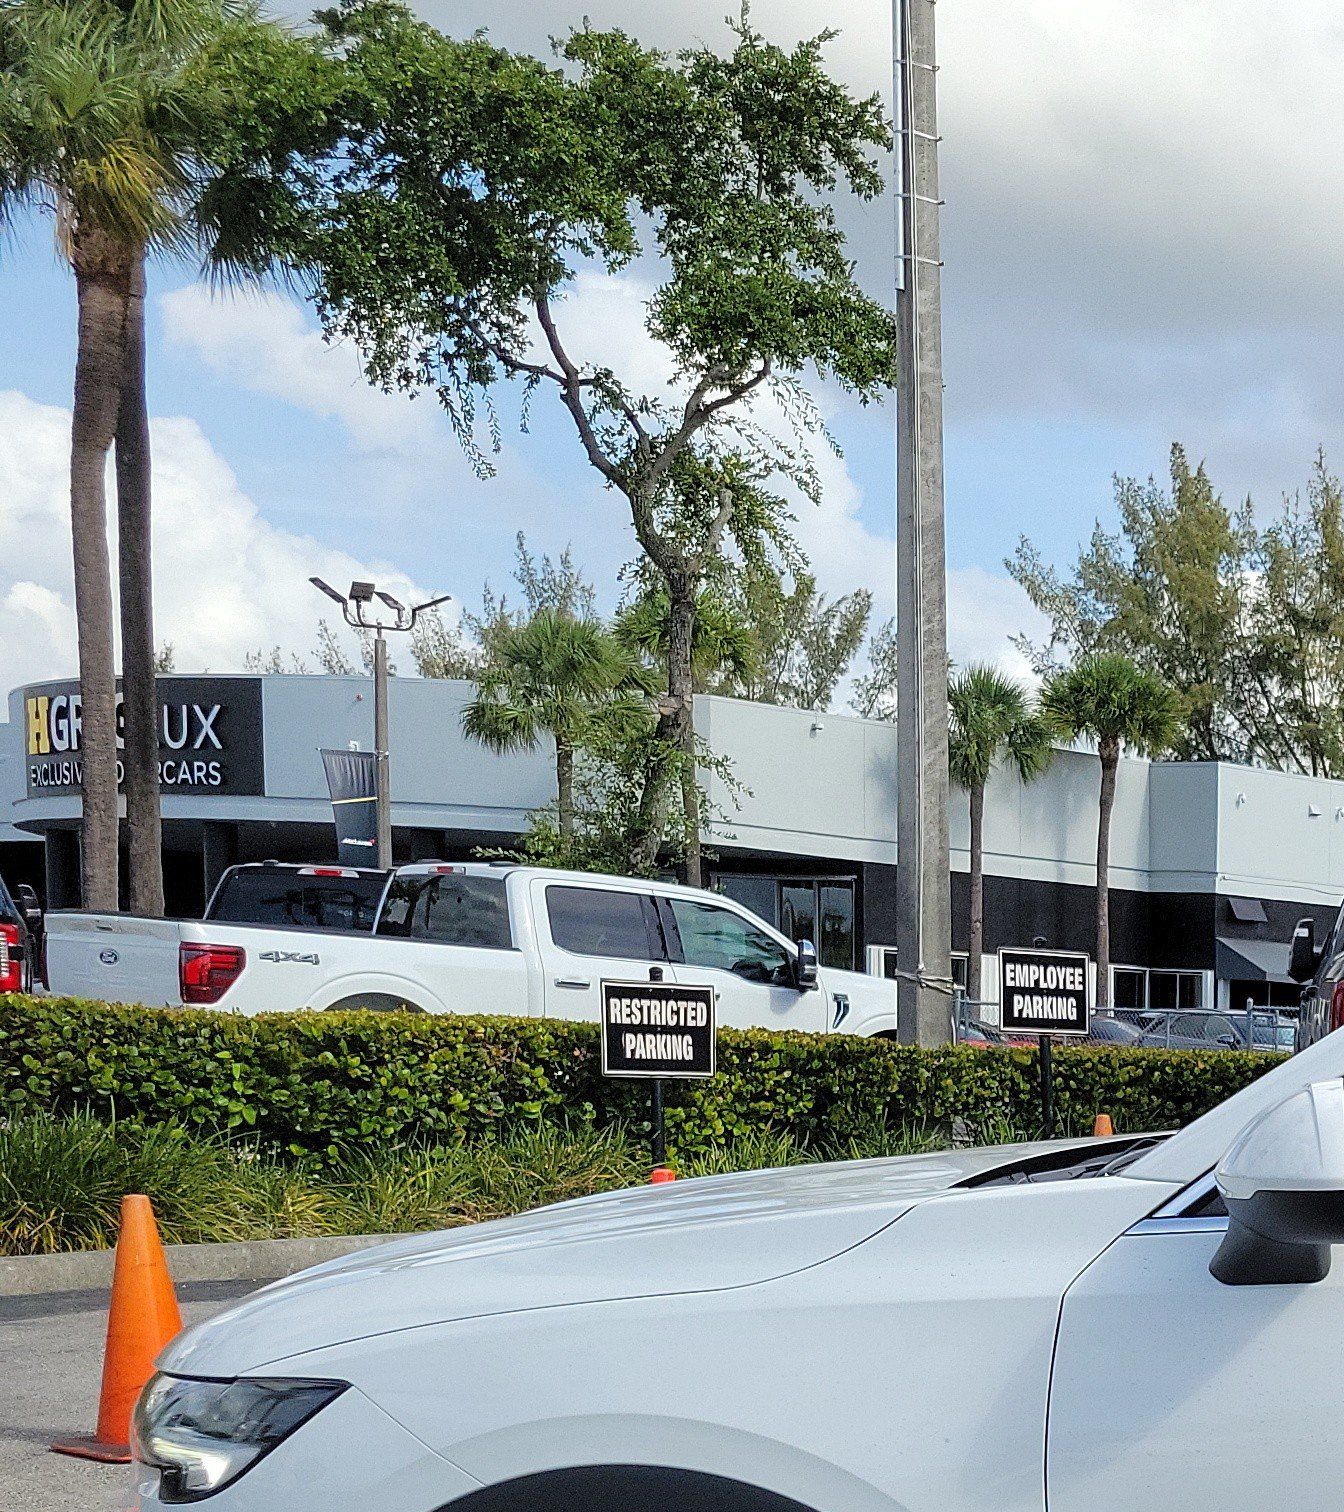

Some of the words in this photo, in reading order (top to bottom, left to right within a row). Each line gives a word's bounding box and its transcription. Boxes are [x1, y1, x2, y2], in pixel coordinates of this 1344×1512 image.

[1005, 963, 1084, 990] EMPLOYEE
[609, 997, 708, 1027] RESTRICTED
[1013, 993, 1077, 1021] PARKING
[625, 1032, 694, 1061] PARKING
